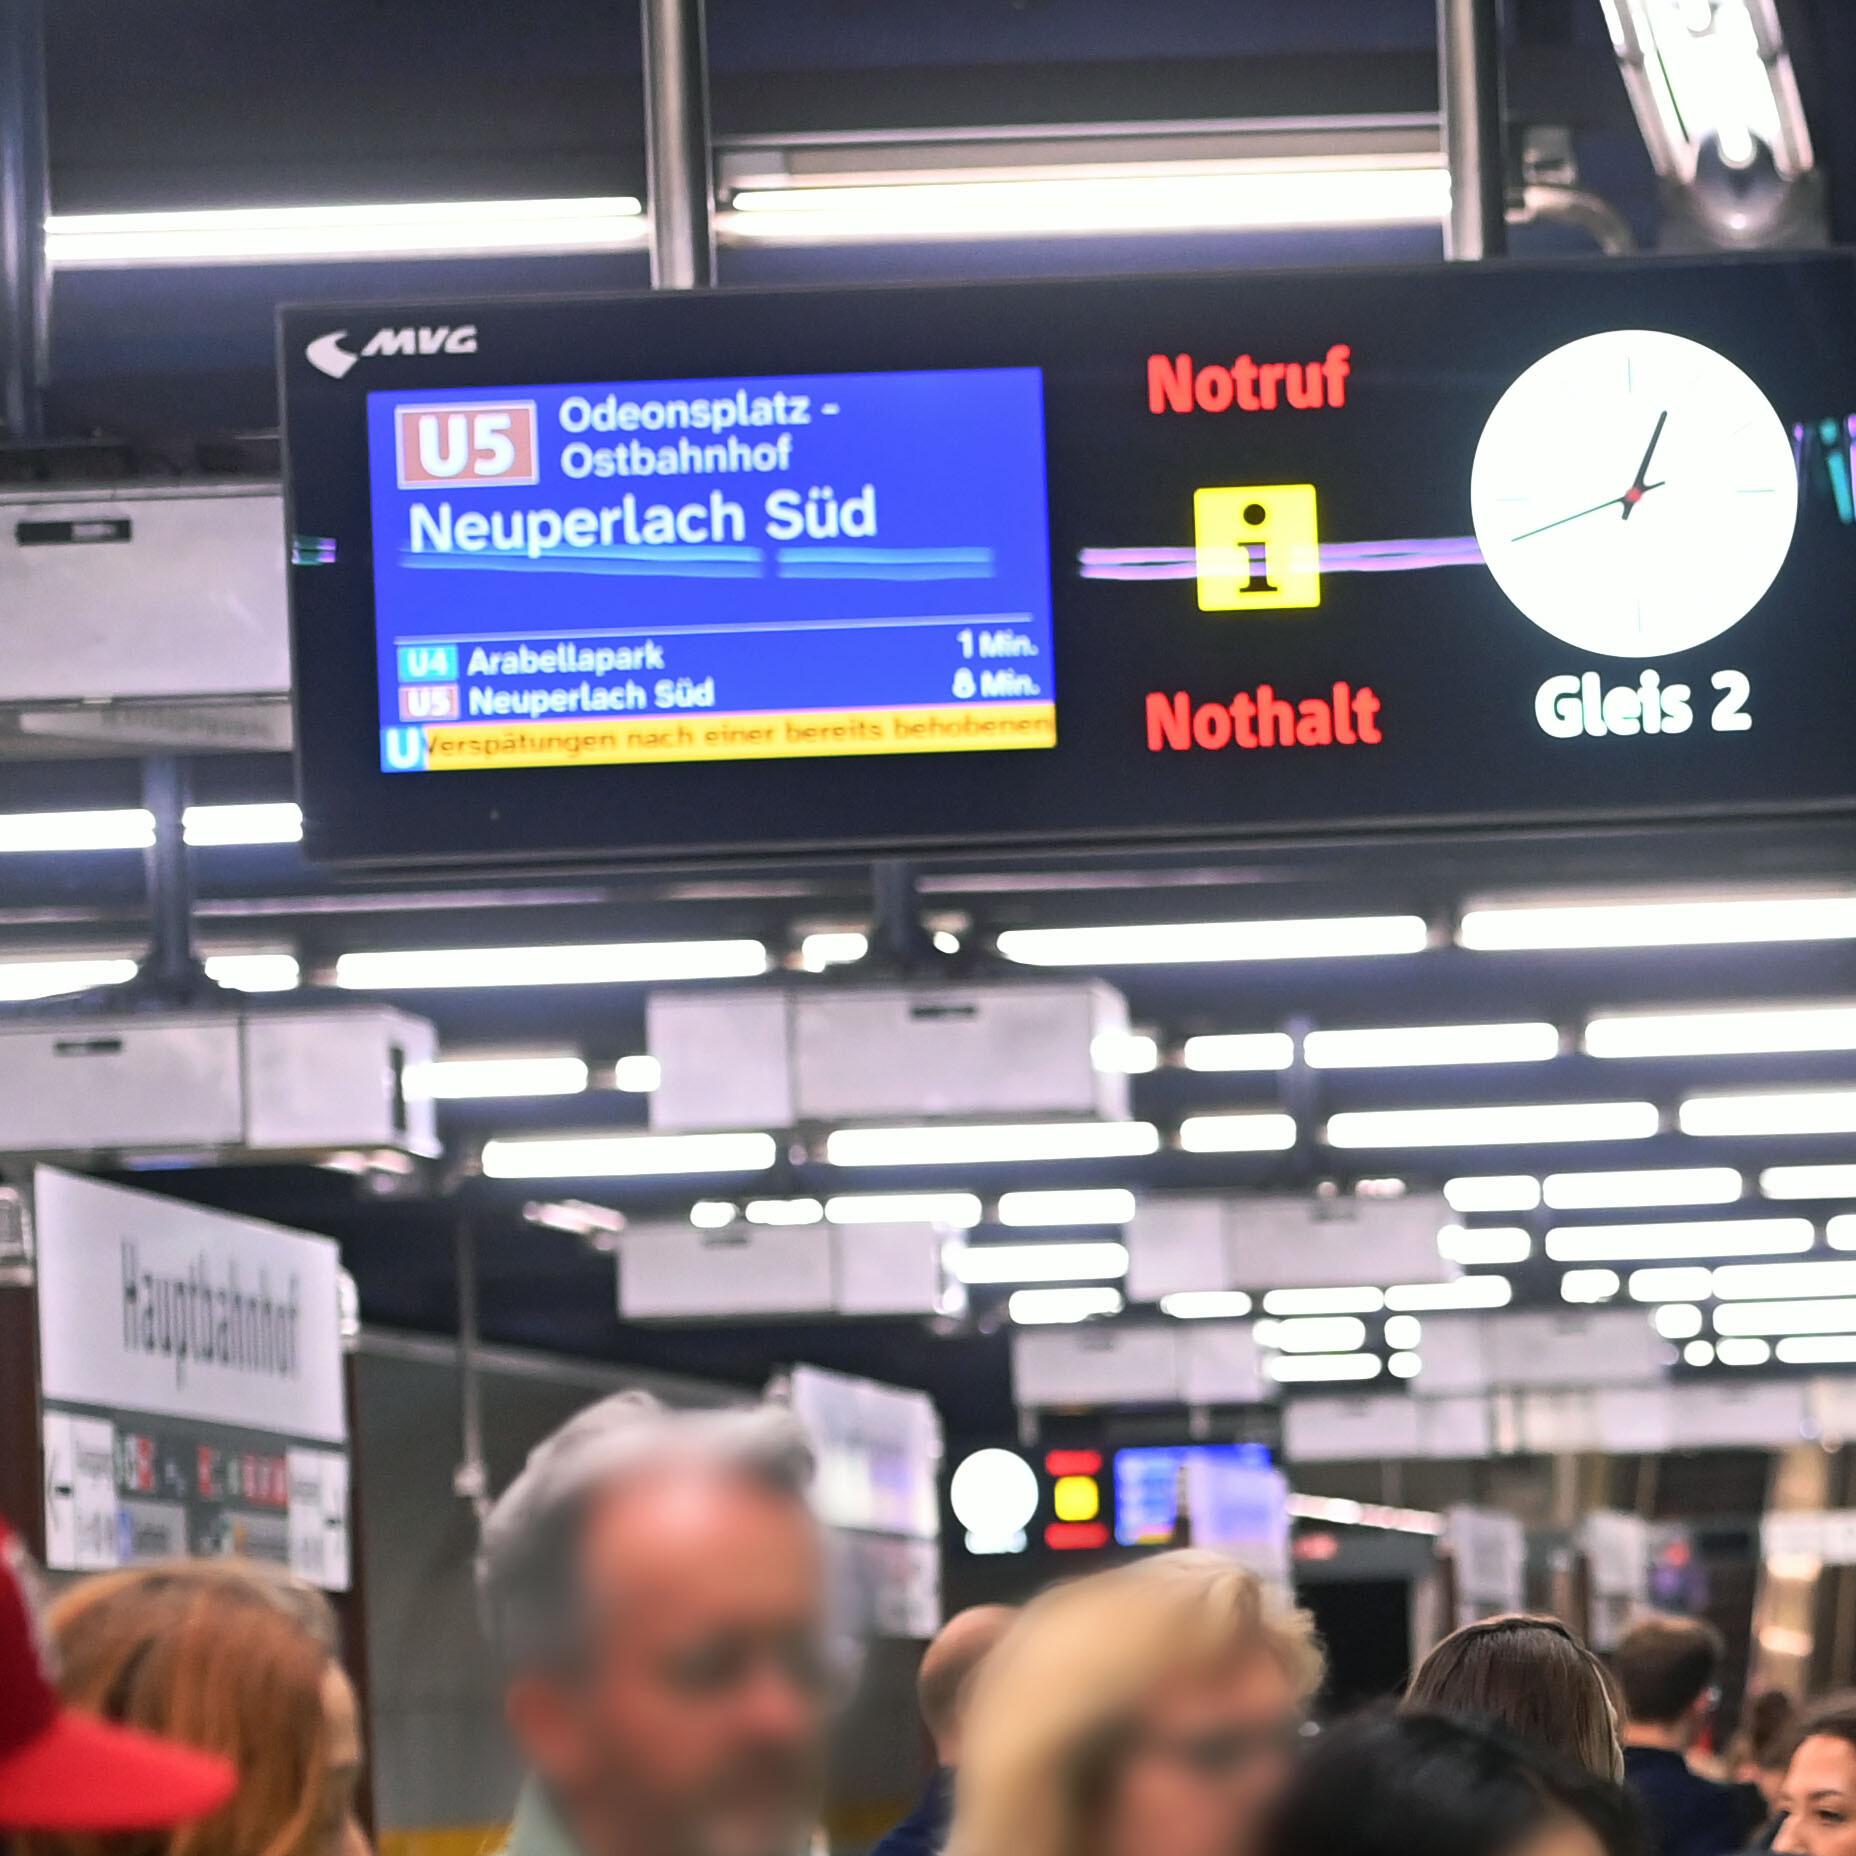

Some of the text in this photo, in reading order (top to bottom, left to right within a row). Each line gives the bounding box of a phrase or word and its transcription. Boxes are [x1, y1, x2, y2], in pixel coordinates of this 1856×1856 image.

[360, 325, 478, 356] MVG
[1147, 344, 1352, 414] Notruf
[559, 389, 812, 433] Odeonsplatz
[418, 413, 516, 477] U5
[561, 432, 793, 478] Ostbahnhof
[409, 484, 877, 558] Neuperlach Süd
[406, 628, 1039, 677] U4 Arabellapark 1 Min.
[407, 667, 1041, 719] U5 Neuperlach Süd 8 Min.
[1145, 680, 1382, 751] Nothalt
[1535, 669, 1753, 739] Gleis 2
[425, 712, 1053, 757] Verspätungen nach einer bereits behobenen
[121, 1238, 299, 1392] Hauptbahnhof
